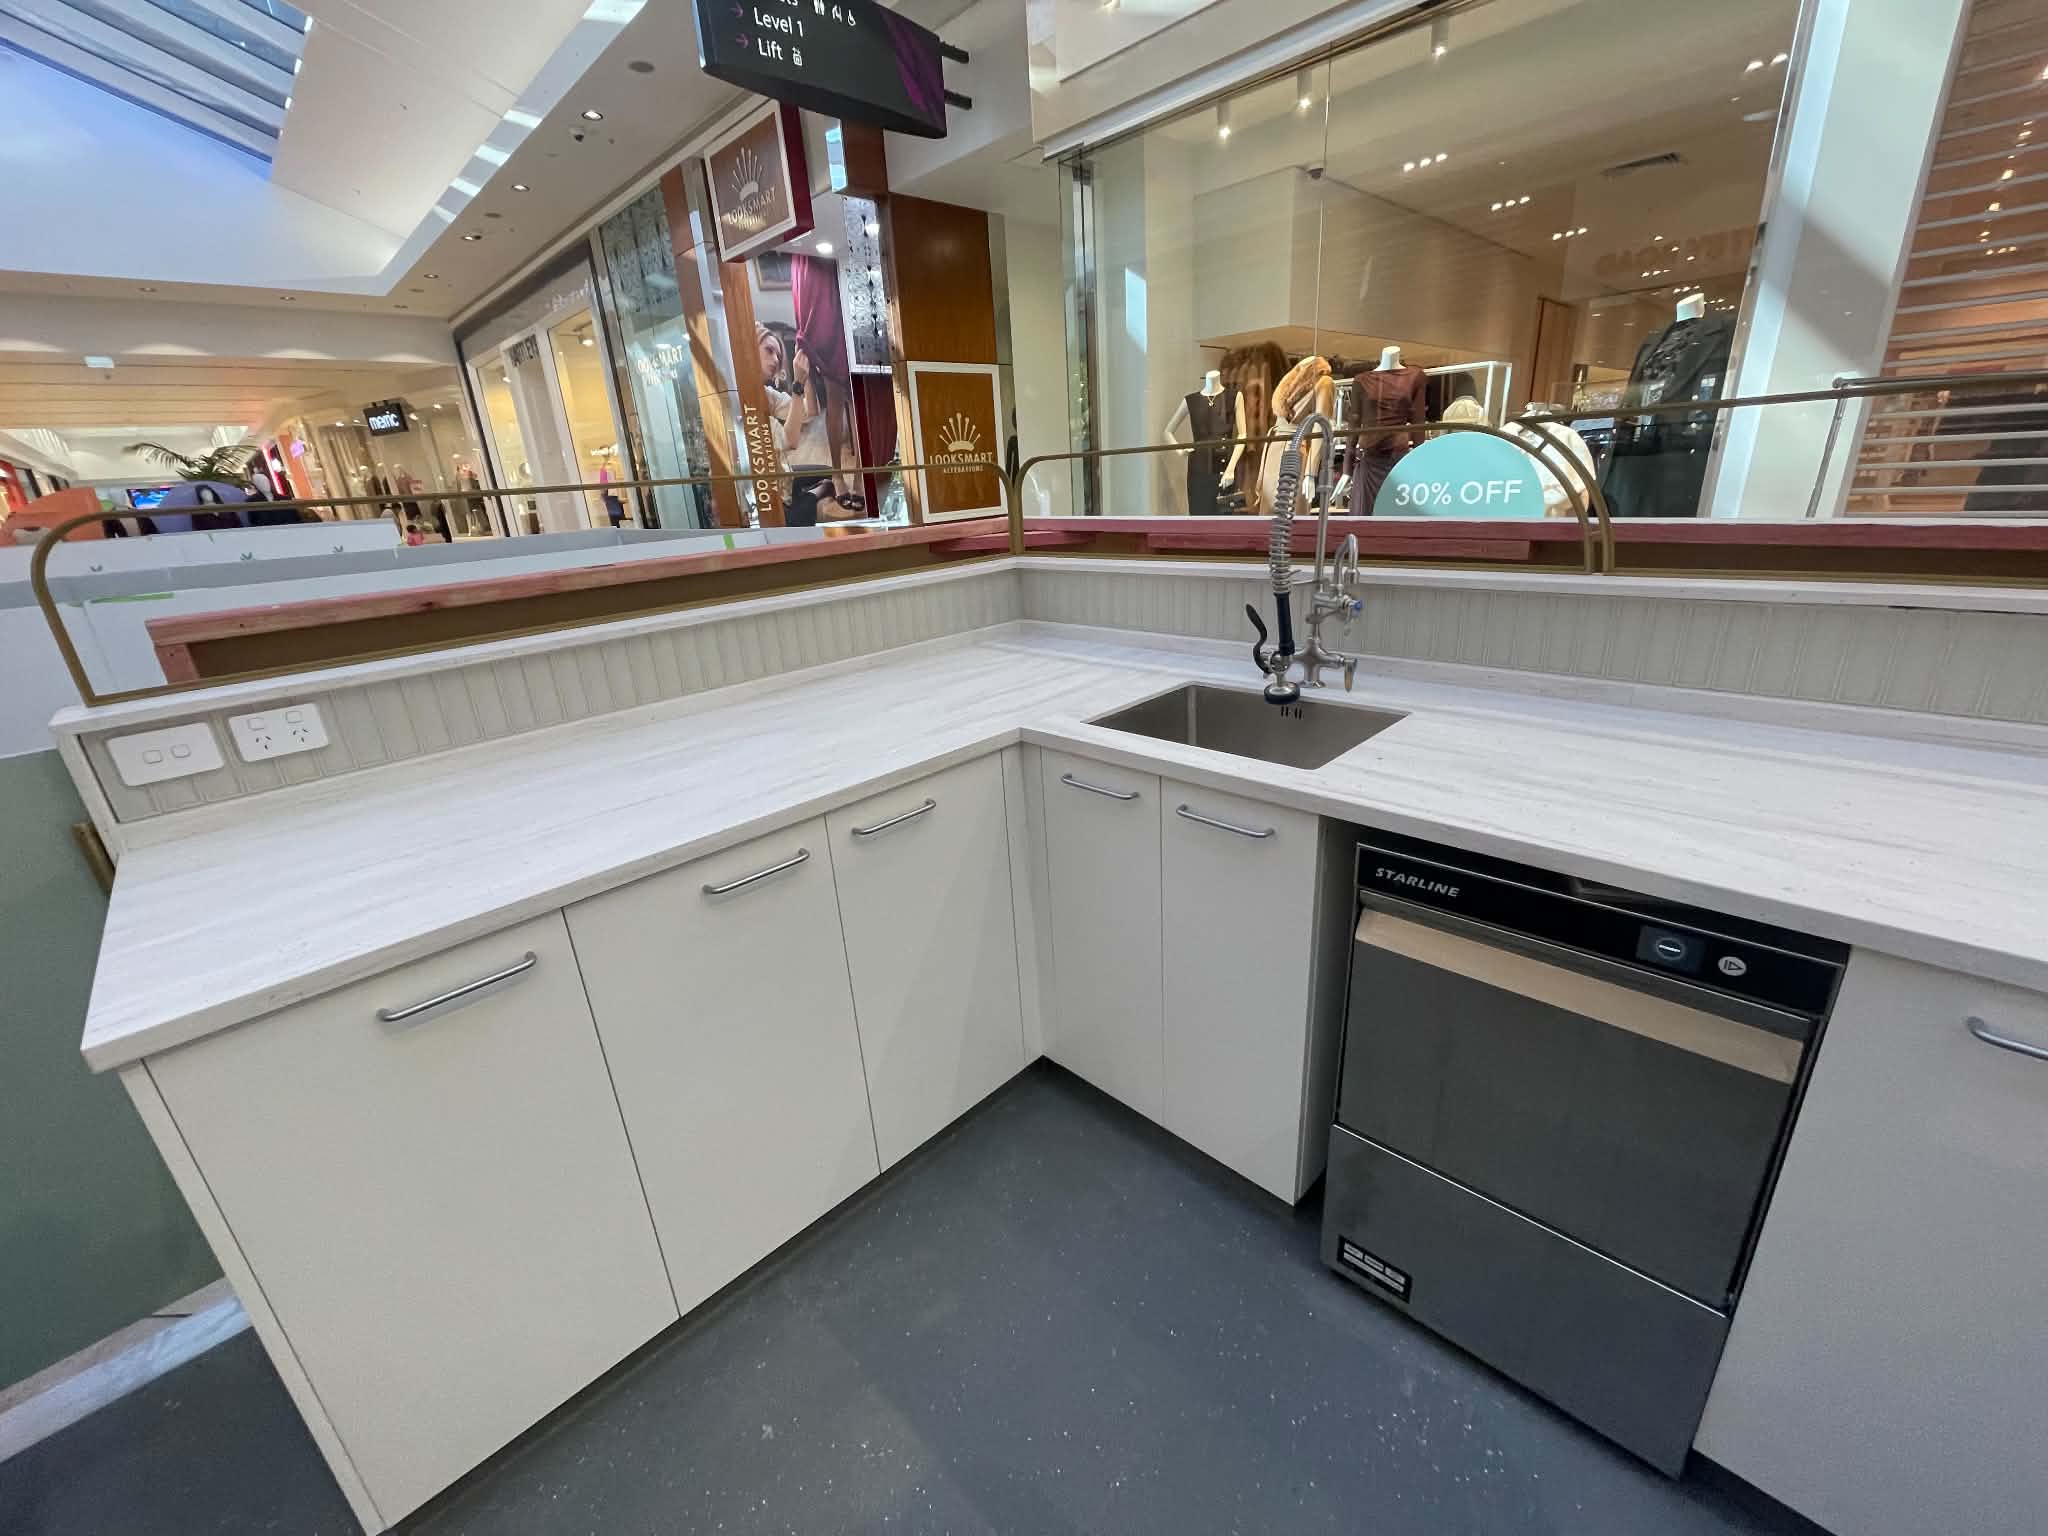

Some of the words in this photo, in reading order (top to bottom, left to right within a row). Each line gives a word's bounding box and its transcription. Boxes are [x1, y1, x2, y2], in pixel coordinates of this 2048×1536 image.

[754, 7, 793, 35] Level
[796, 20, 804, 37] 1
[758, 37, 783, 60] Lift
[728, 187, 776, 225] LOOKSMART
[762, 423, 778, 492] ALERATIONS
[929, 452, 993, 465] LOOKSMART
[1395, 482, 1452, 505] 30%
[1460, 480, 1523, 504] OFF
[1375, 867, 1460, 897] STARLINE
